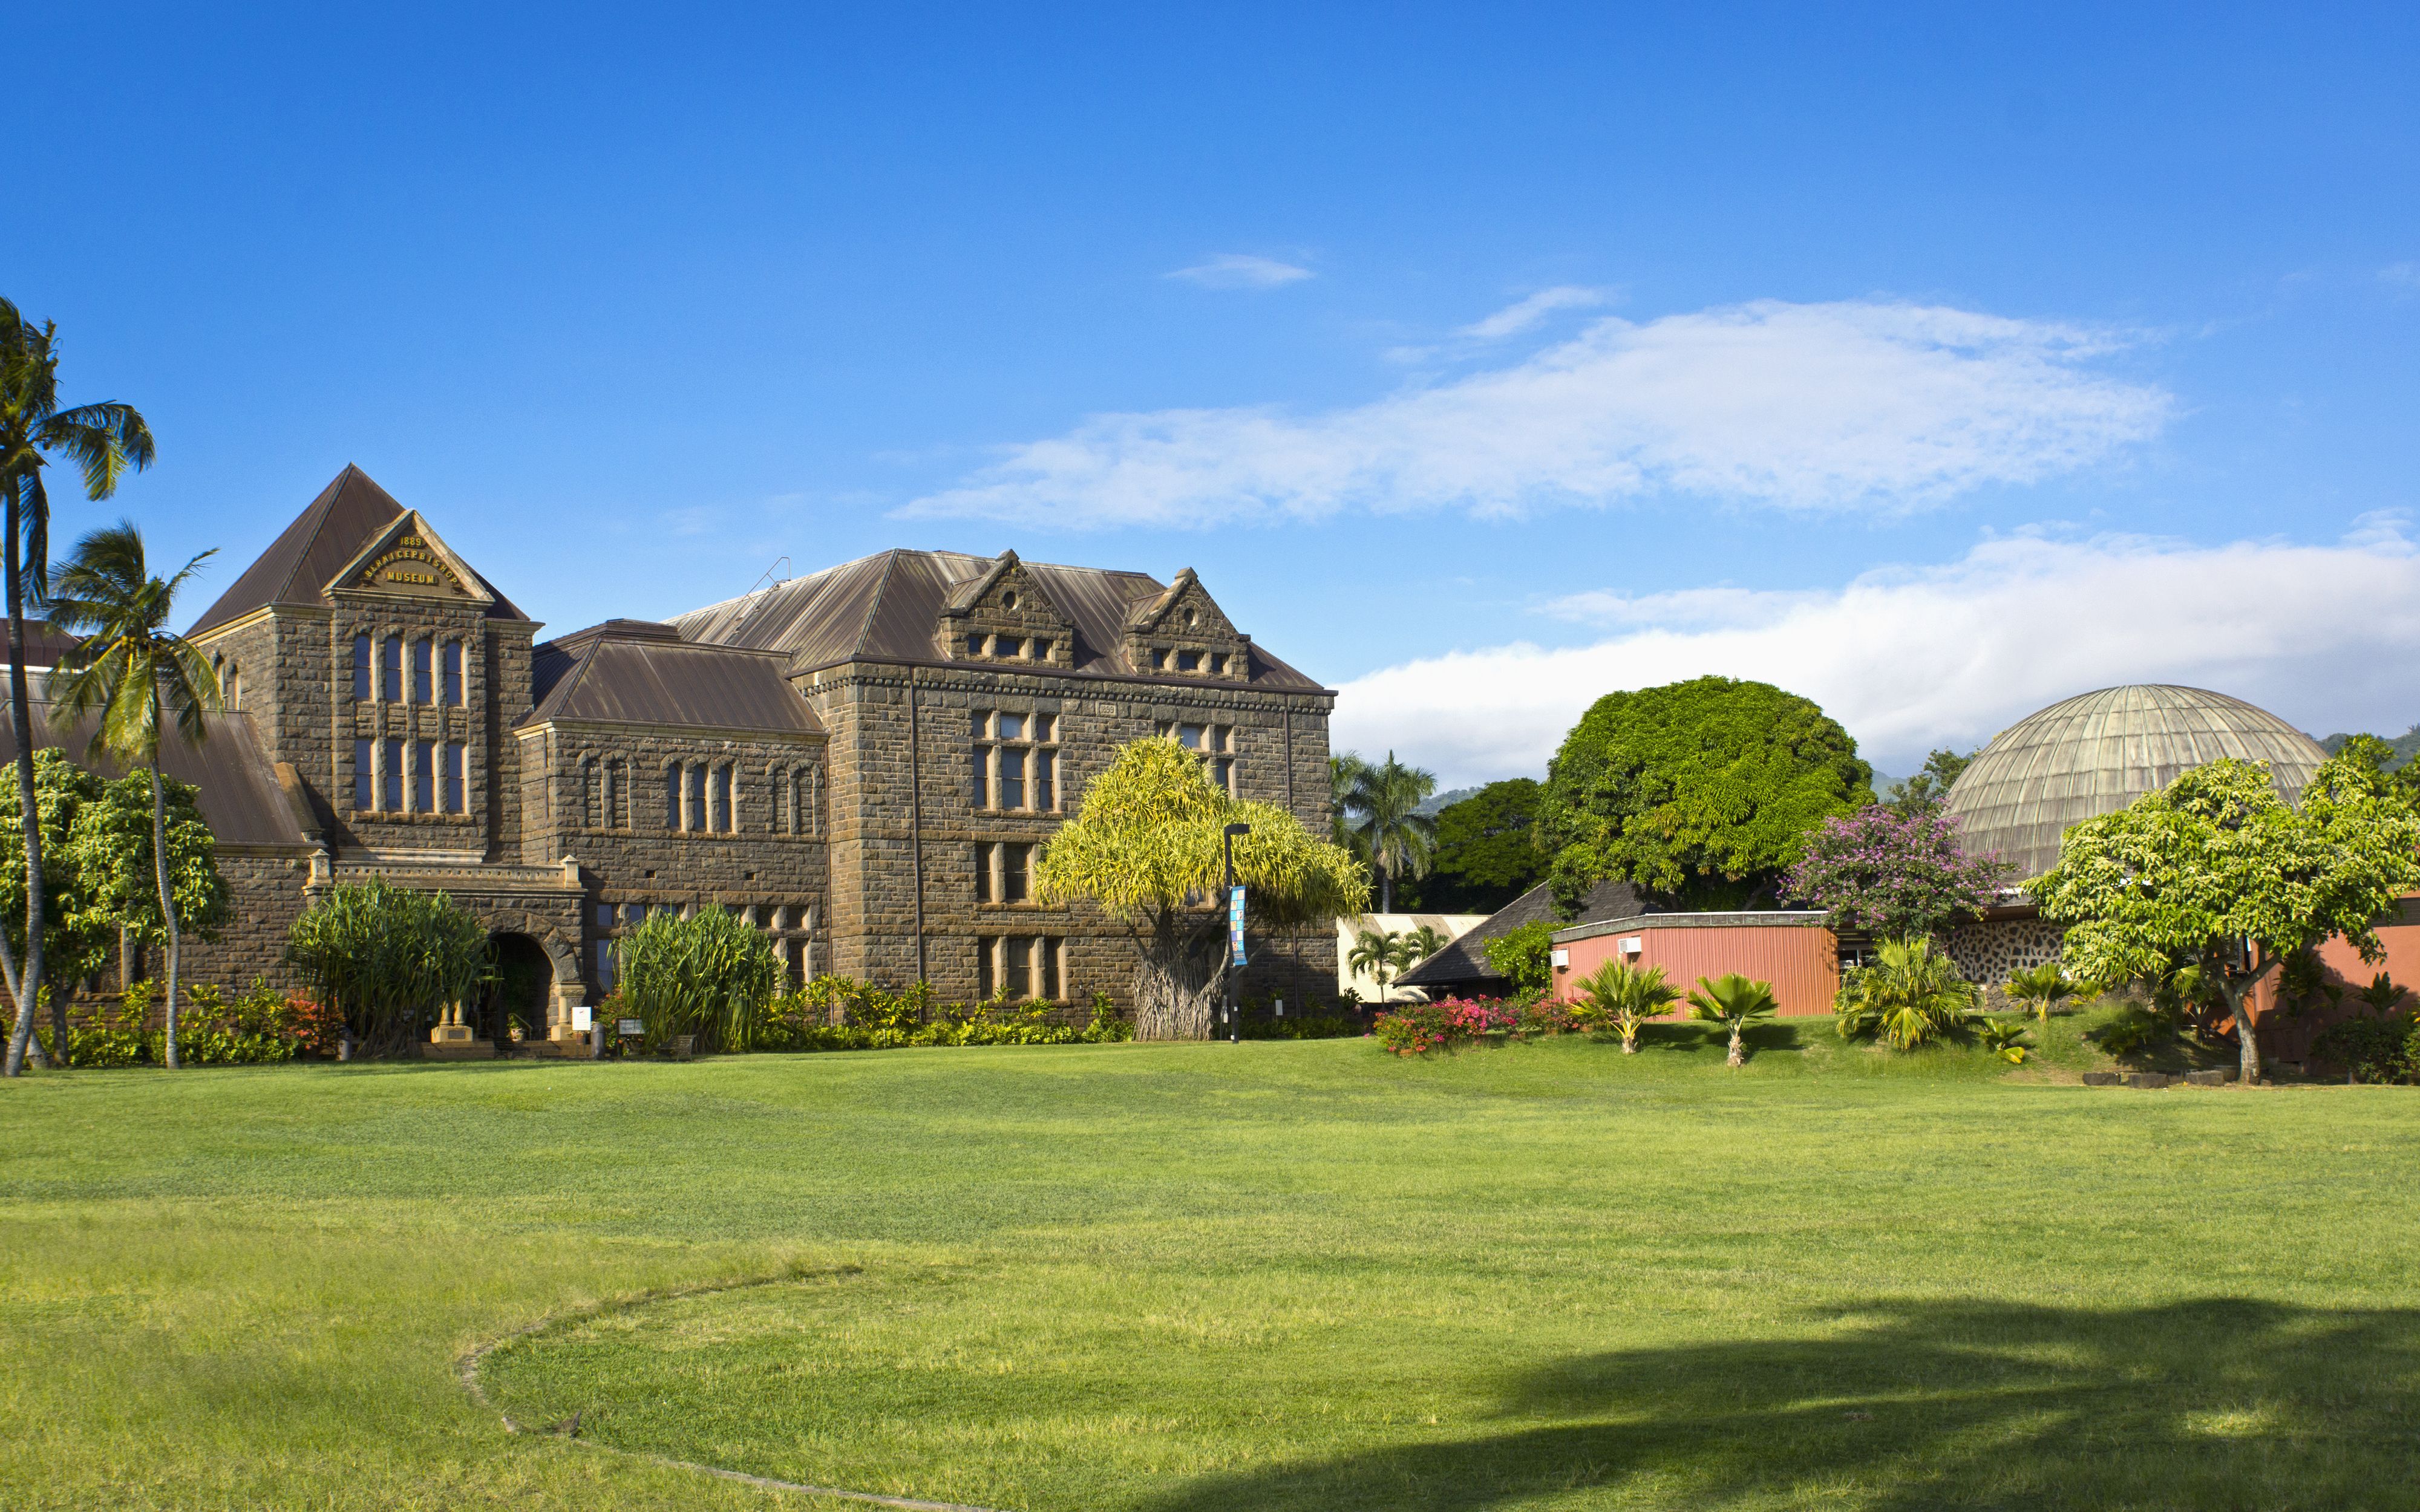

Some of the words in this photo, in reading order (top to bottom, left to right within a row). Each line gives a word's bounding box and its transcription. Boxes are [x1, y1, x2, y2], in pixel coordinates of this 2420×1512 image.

[401, 536, 422, 546] 1889
[364, 550, 410, 578] BERNICE
[419, 552, 458, 583] BISHOP
[387, 572, 434, 584] MUSEUM
[1100, 705, 1114, 714] 1899
